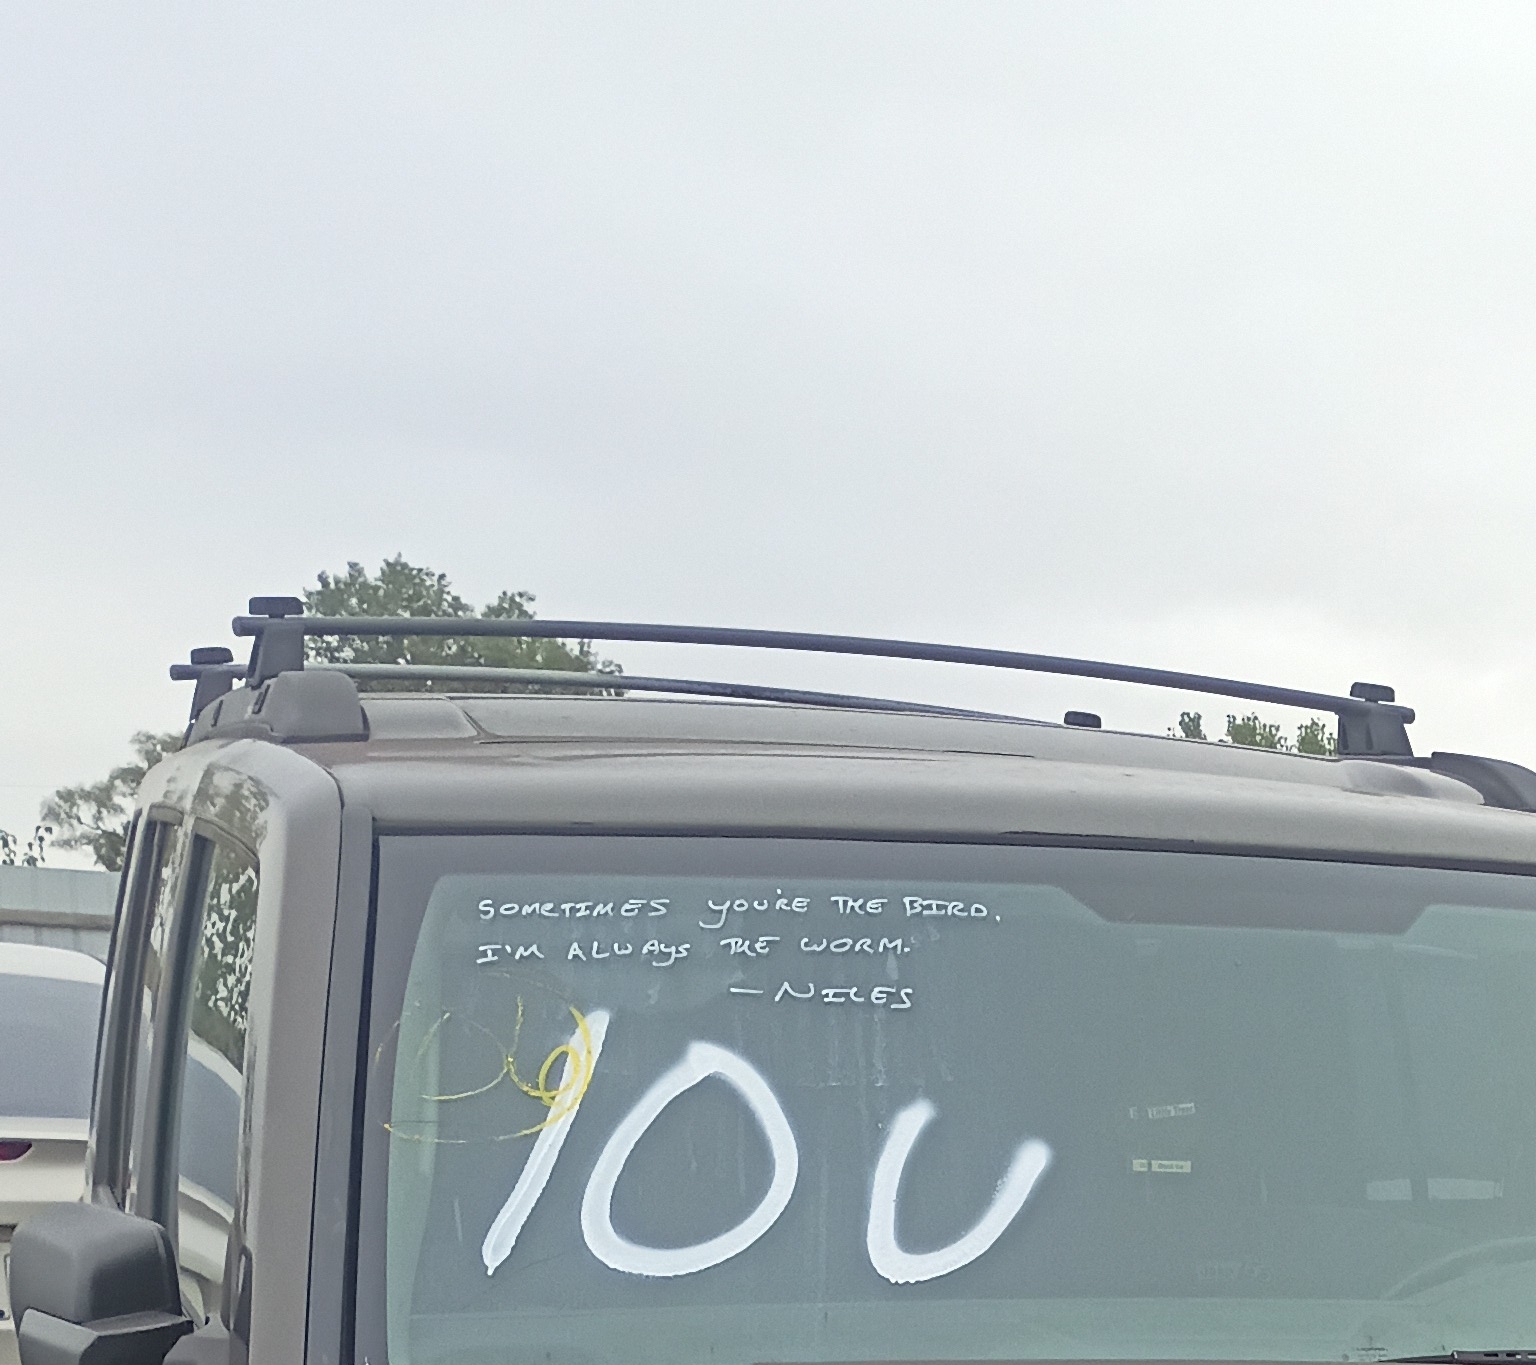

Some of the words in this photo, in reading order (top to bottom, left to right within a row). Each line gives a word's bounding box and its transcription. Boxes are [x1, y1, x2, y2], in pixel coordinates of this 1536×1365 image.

[478, 899, 671, 920] SOMETIMES
[698, 888, 811, 929] YOU'RE
[830, 895, 888, 915] THE
[902, 896, 1001, 922] BIRD.
[476, 941, 545, 964] I'M
[566, 939, 691, 967] ALWAYS
[719, 936, 780, 956] THE
[800, 937, 911, 955] WORM.
